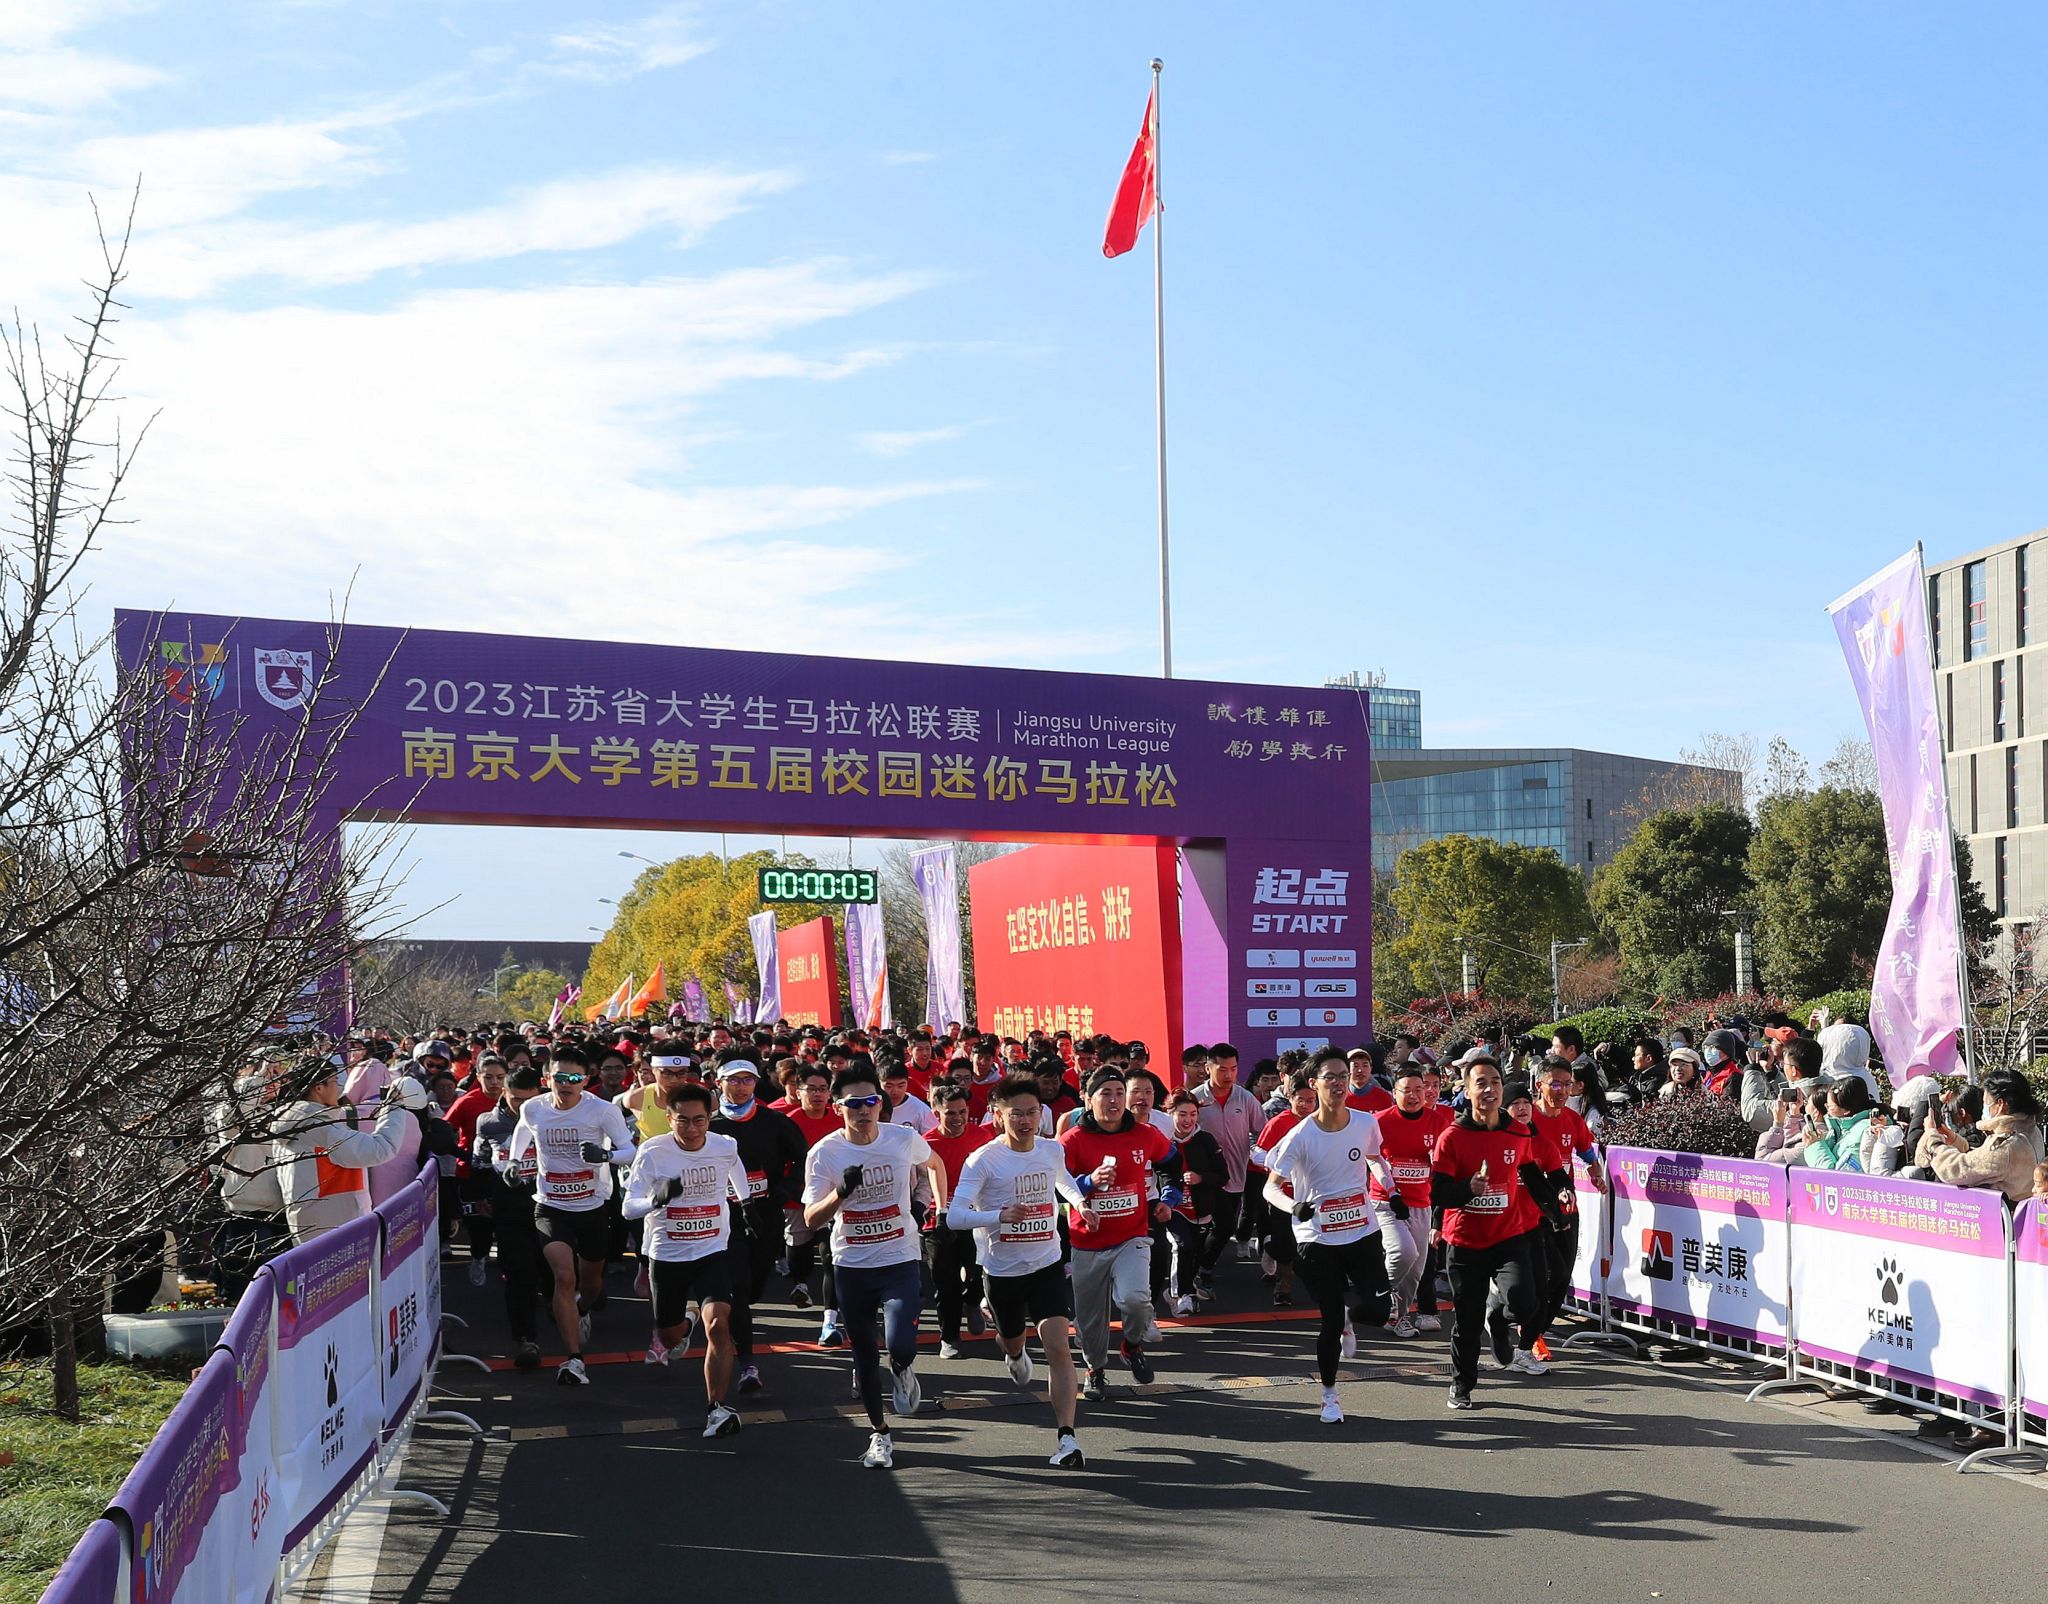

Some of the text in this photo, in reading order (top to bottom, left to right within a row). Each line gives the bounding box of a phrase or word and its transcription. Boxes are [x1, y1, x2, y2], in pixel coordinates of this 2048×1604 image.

[404, 677, 981, 743] 2023江苏省大学生马拉松联赛
[1013, 710, 1177, 738] Jiangsu University
[1014, 728, 1170, 756] Marathon League
[401, 726, 1178, 808] 南京大学第五届校园迷你马拉松
[764, 872, 874, 900] 00:00:03
[1252, 867, 1349, 906] 起点
[1252, 914, 1348, 934] START
[1313, 984, 1347, 993] ASUS
[1399, 1168, 1425, 1177] S0224
[553, 1183, 587, 1193] S0306
[1842, 1186, 1938, 1212] 2023江苏省大学生马拉松联赛
[1098, 1198, 1132, 1210] S0524
[1328, 1208, 1361, 1223] S0104
[676, 1219, 713, 1231] S0108
[855, 1222, 892, 1235] S0116
[1011, 1220, 1048, 1233] S0100
[1842, 1202, 1982, 1241] 南京大学第五届校园迷你马拉松
[1681, 1237, 1748, 1281] 普美康
[1868, 1307, 1913, 1332] KELME
[1868, 1328, 1913, 1351] 卡尔美体育
